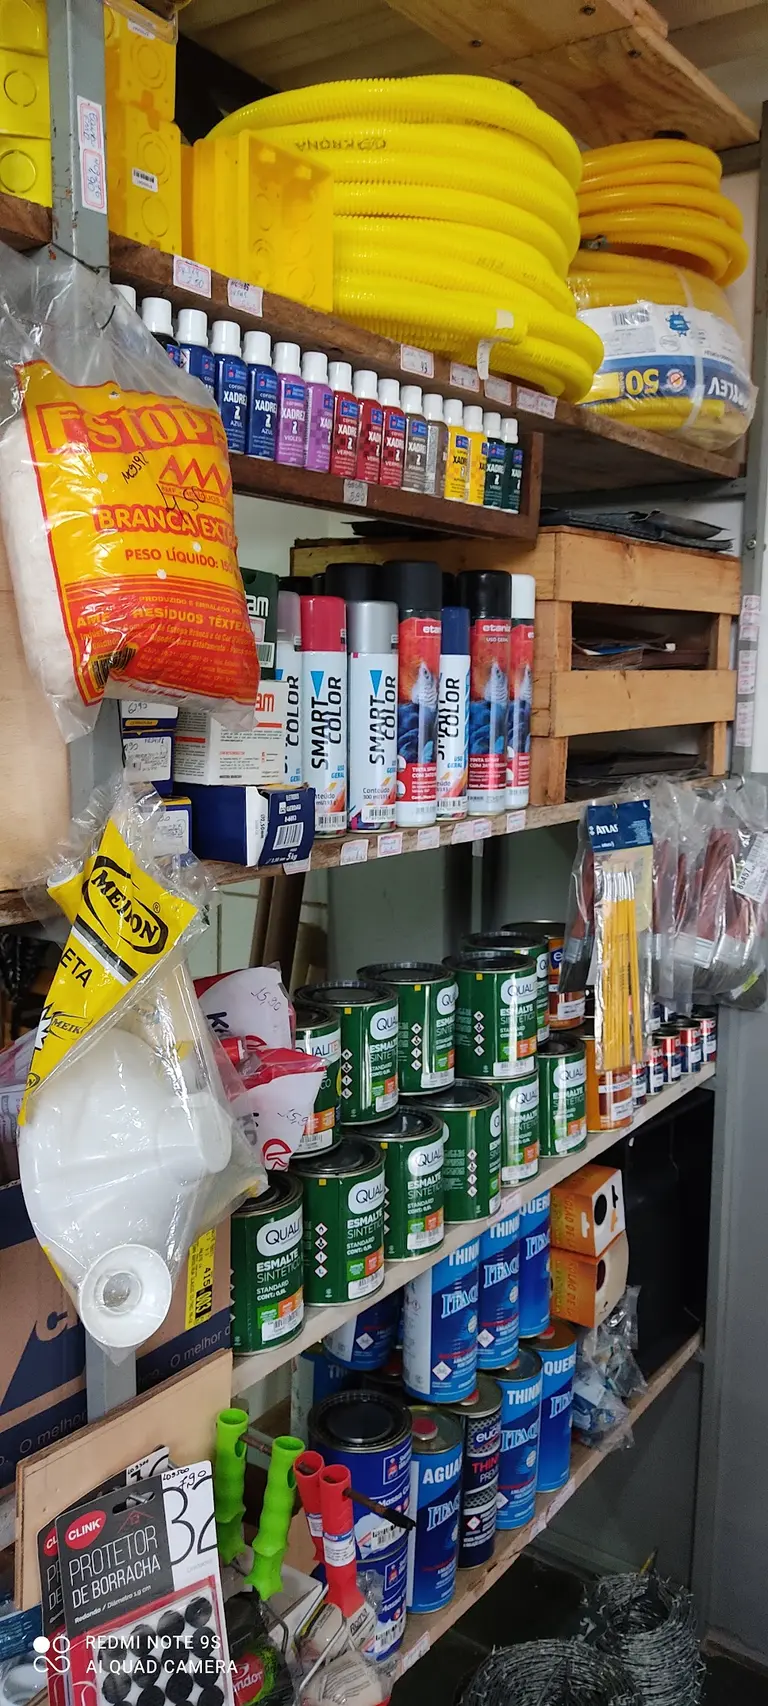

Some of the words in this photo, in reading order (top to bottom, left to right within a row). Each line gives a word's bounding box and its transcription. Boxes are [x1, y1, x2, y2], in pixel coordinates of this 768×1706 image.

[625, 368, 660, 396] 50
[99, 507, 196, 535] BRANCA
[125, 547, 162, 563] PESO
[327, 676, 342, 744] COLOR
[384, 674, 397, 741] COLOR
[445, 677, 460, 738] COLOR
[310, 696, 329, 770] SMART
[369, 694, 388, 766] SMART
[362, 786, 390, 795] Conteúdo
[596, 823, 619, 836] ATLAS
[499, 1004, 534, 1017] ESALTE
[407, 1171, 442, 1190] ESMALTE
[407, 1197, 435, 1209] STANDARD
[346, 1208, 383, 1230] ESMALTE
[346, 1236, 375, 1250] STANDARD
[256, 1248, 299, 1273] ESMALTE
[256, 1279, 290, 1295] STANDARD
[195, 1290, 212, 1314] 003
[170, 1353, 181, 1369] O
[183, 1329, 222, 1359] melhor
[20, 1438, 32, 1454] O
[37, 1411, 87, 1445] melhor
[68, 1519, 102, 1541] CLINK
[68, 1525, 158, 1587] PROTETOR
[72, 1584, 90, 1610] DE
[91, 1554, 161, 1604] BORRACHA
[74, 1607, 101, 1624] Redondo
[142, 1584, 152, 1593] cm
